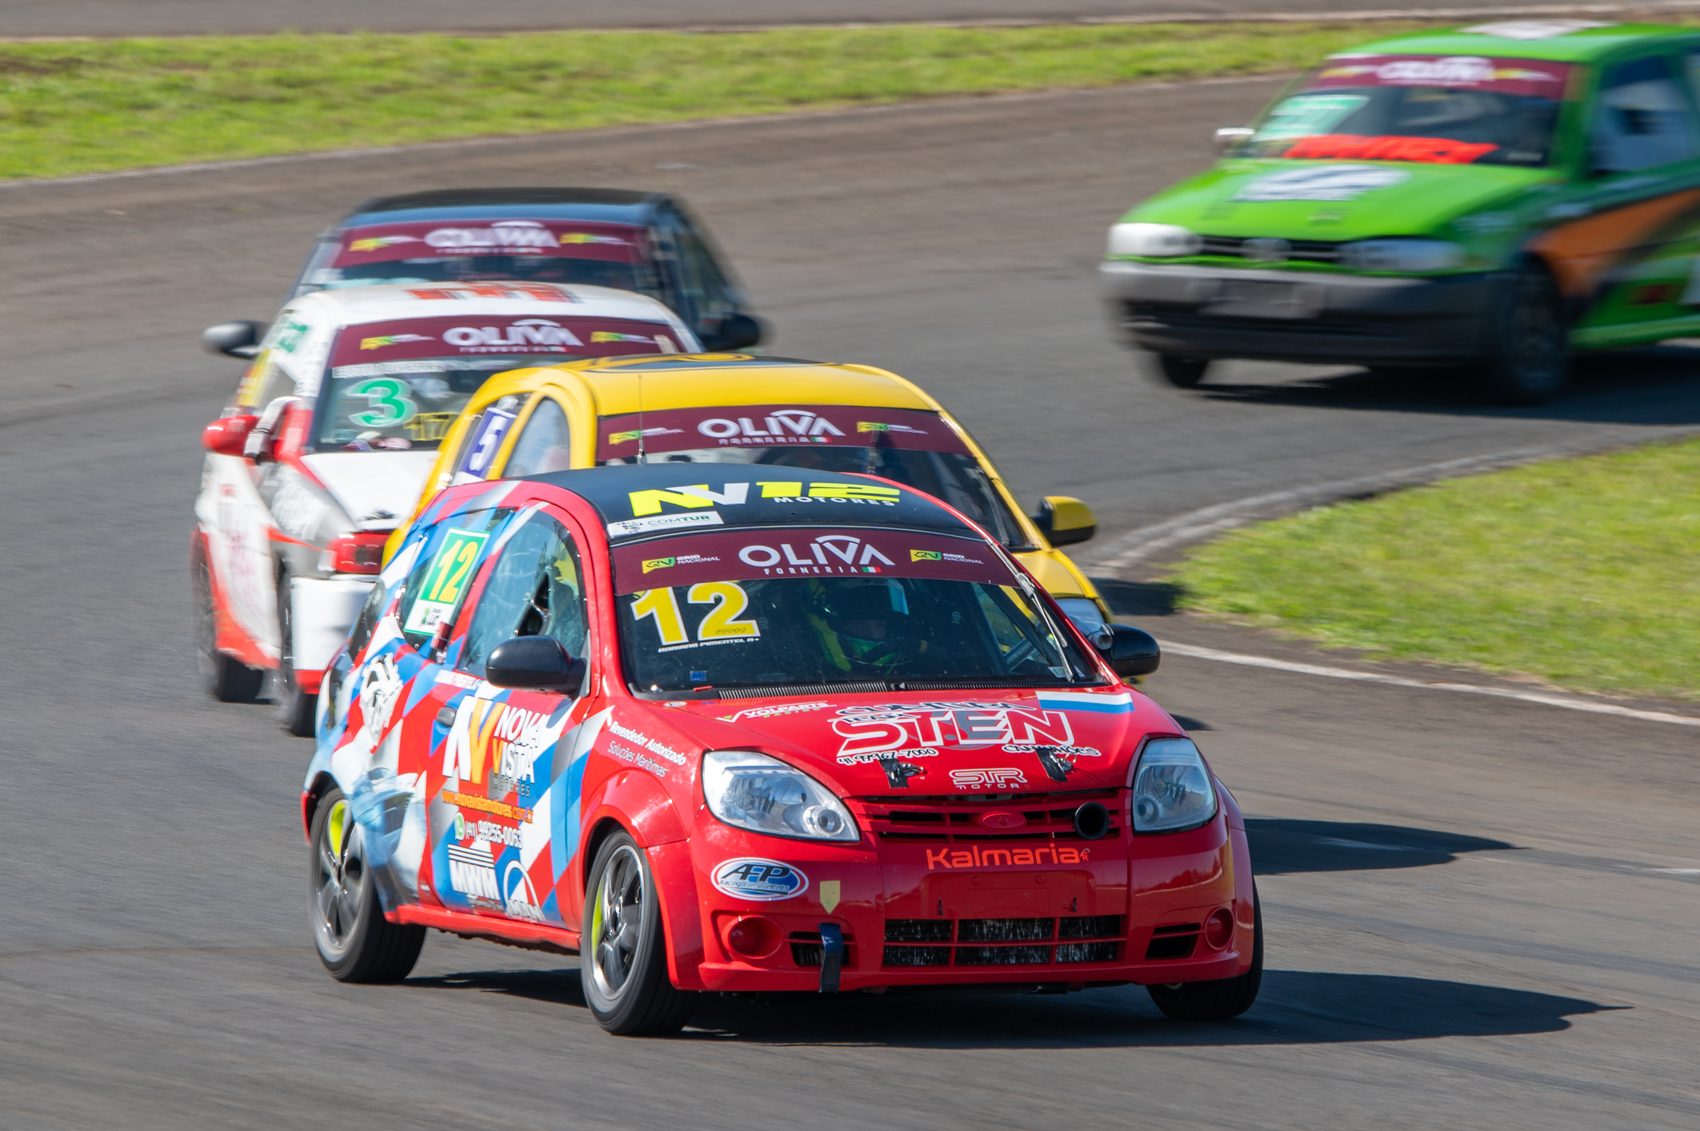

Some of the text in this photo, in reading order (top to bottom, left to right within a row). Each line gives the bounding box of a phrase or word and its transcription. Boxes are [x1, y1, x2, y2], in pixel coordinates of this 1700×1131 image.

[443, 319, 584, 347] OLIVA
[348, 378, 418, 428] 3
[697, 409, 847, 438] OLIVA
[773, 497, 896, 507] MOTORES
[738, 535, 896, 567] OLIVA
[428, 539, 480, 605] 12
[764, 566, 858, 575] FORNERIA
[630, 581, 761, 646] 12
[494, 705, 551, 745] NOVA
[832, 711, 1075, 757] STEN
[492, 738, 535, 784] VISTA
[644, 738, 687, 766] Autorizado
[949, 767, 1028, 785] STR
[926, 843, 1081, 870] Kalmaria
